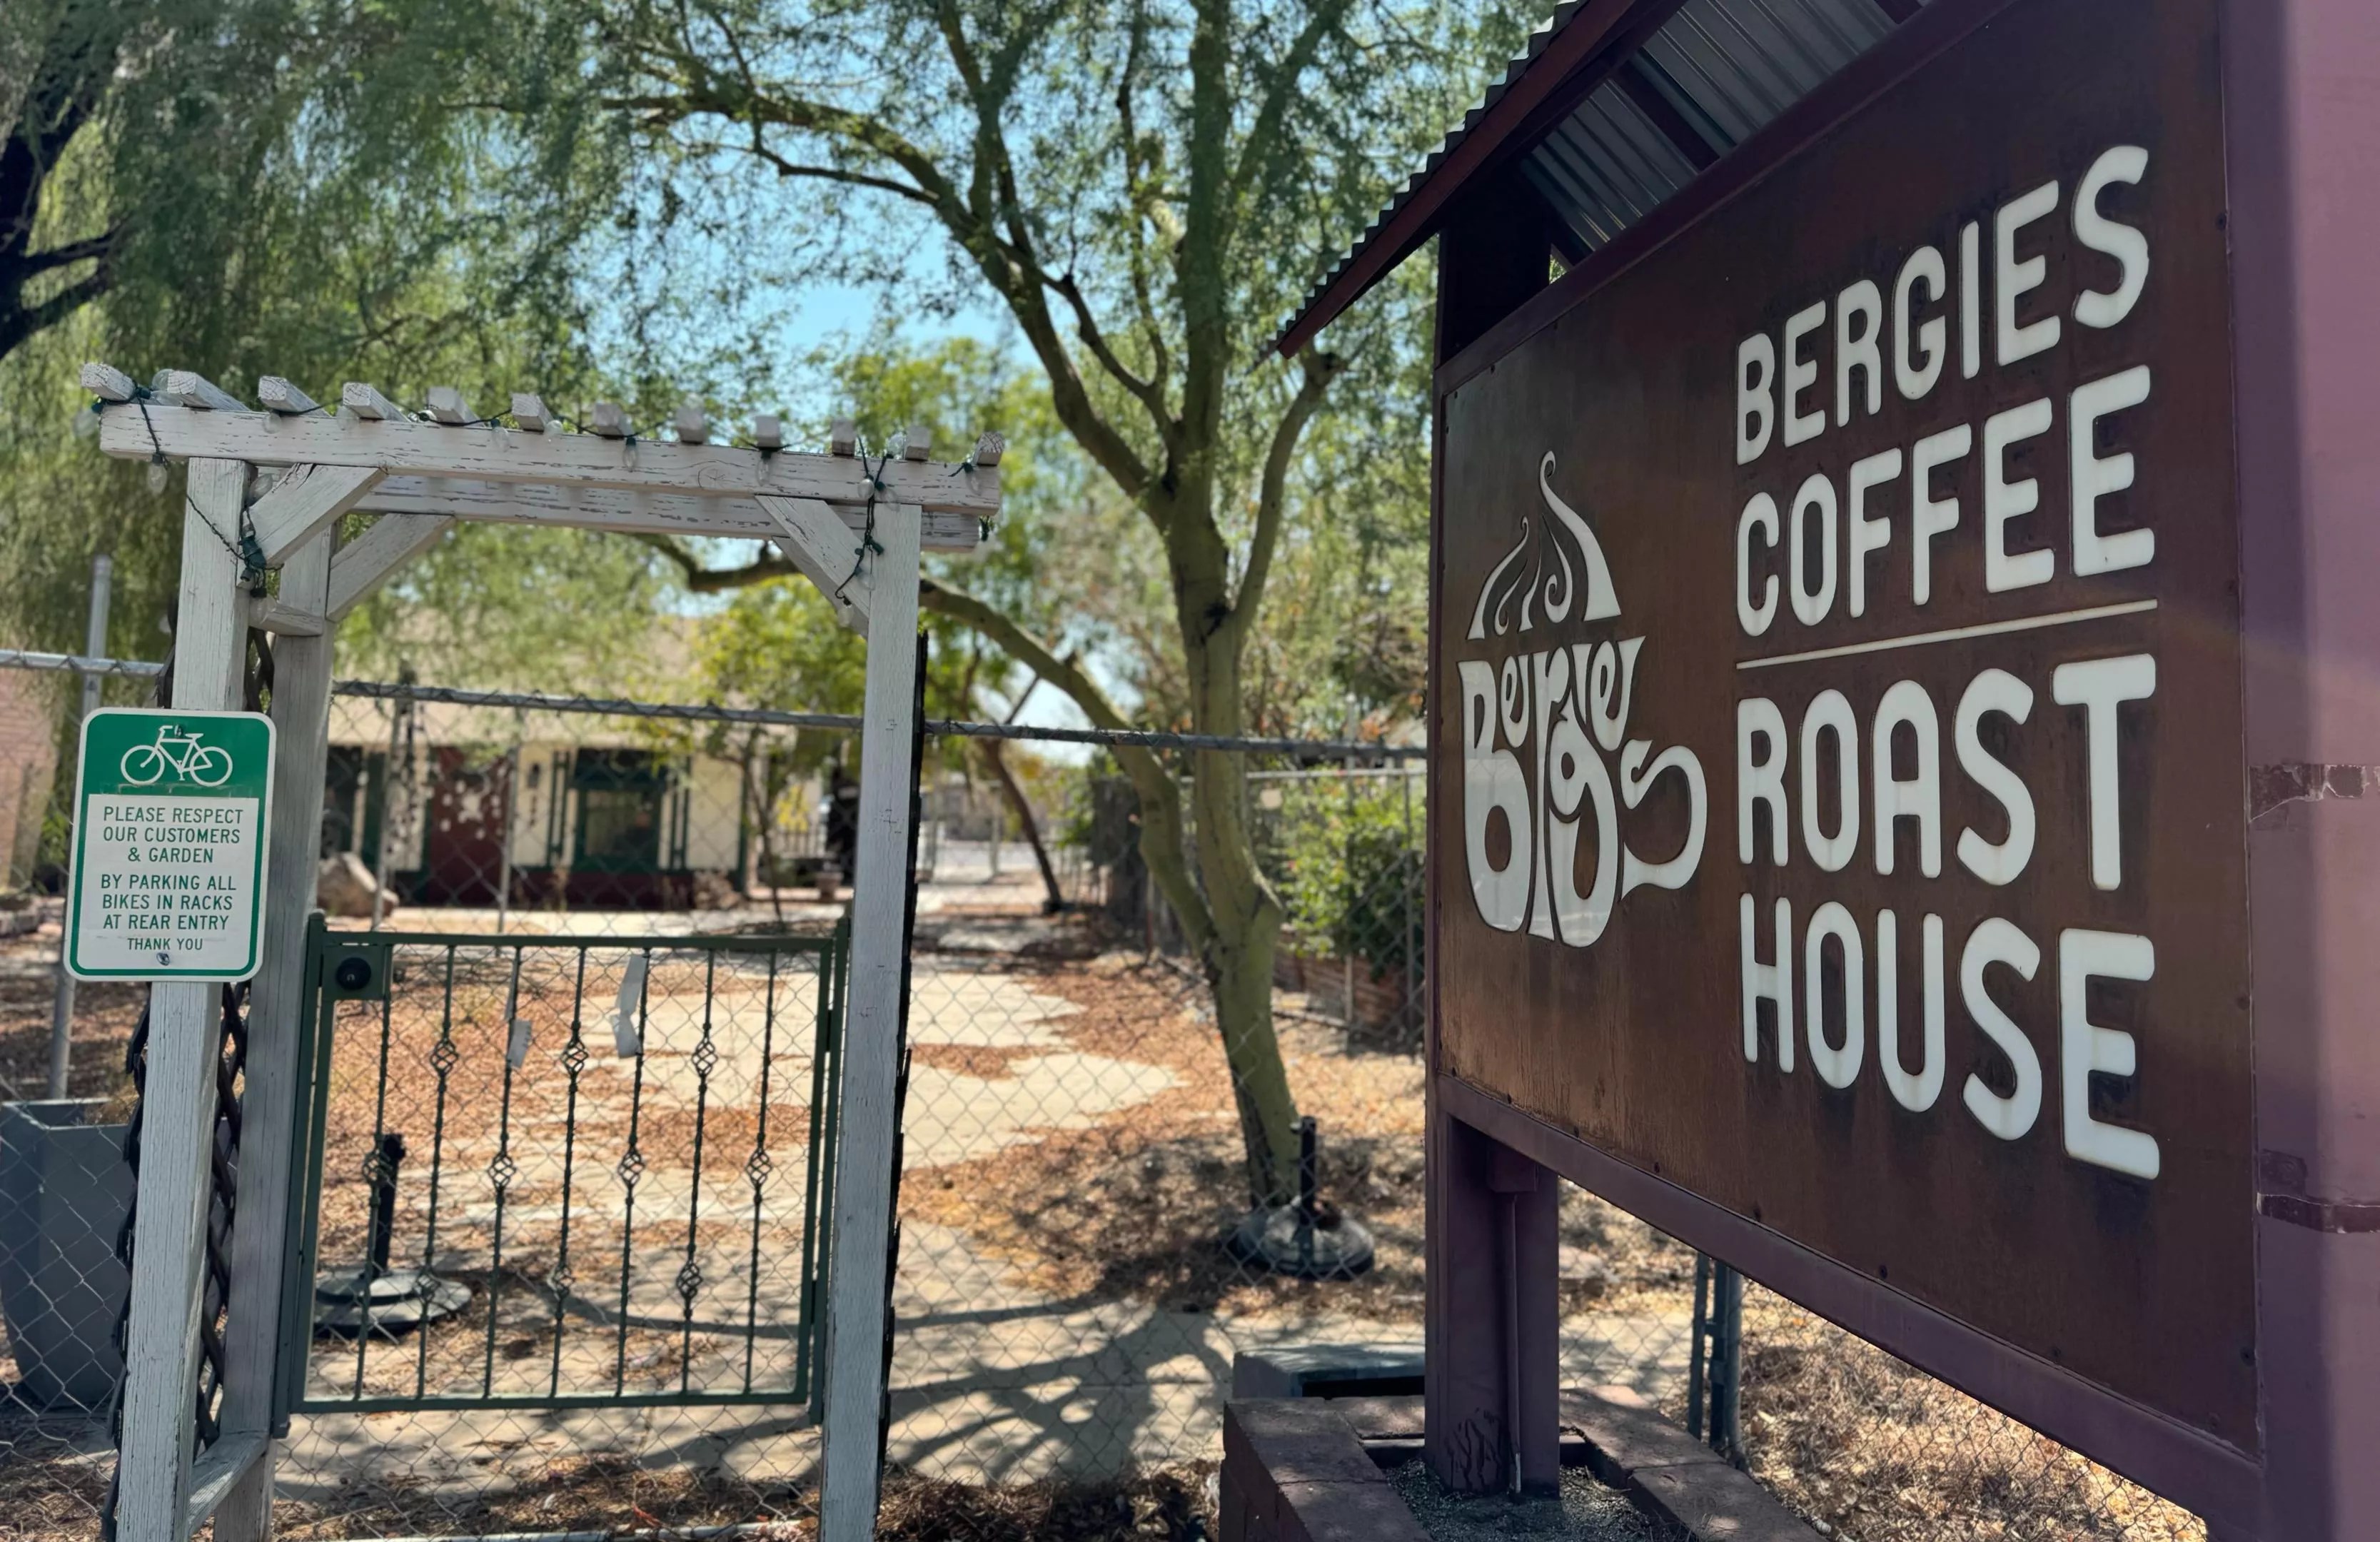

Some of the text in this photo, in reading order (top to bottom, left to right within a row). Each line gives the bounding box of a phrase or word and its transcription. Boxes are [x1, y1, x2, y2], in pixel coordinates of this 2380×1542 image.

[1737, 146, 2150, 465] BERGIES
[1737, 365, 2155, 636] COFFEE
[1738, 652, 2157, 891] ROAST
[103, 805, 244, 825] PLEASE RESPECT
[103, 826, 241, 845] OUR CUSTOMERS
[127, 846, 214, 864] & GARDEN
[101, 873, 237, 891] BY PARKING ALL
[102, 893, 233, 911] BIKES IN RACKS
[102, 914, 229, 931] AT REAR ENTRY
[126, 937, 203, 952] THANK YOU
[1740, 893, 2160, 1179] HOUSE
